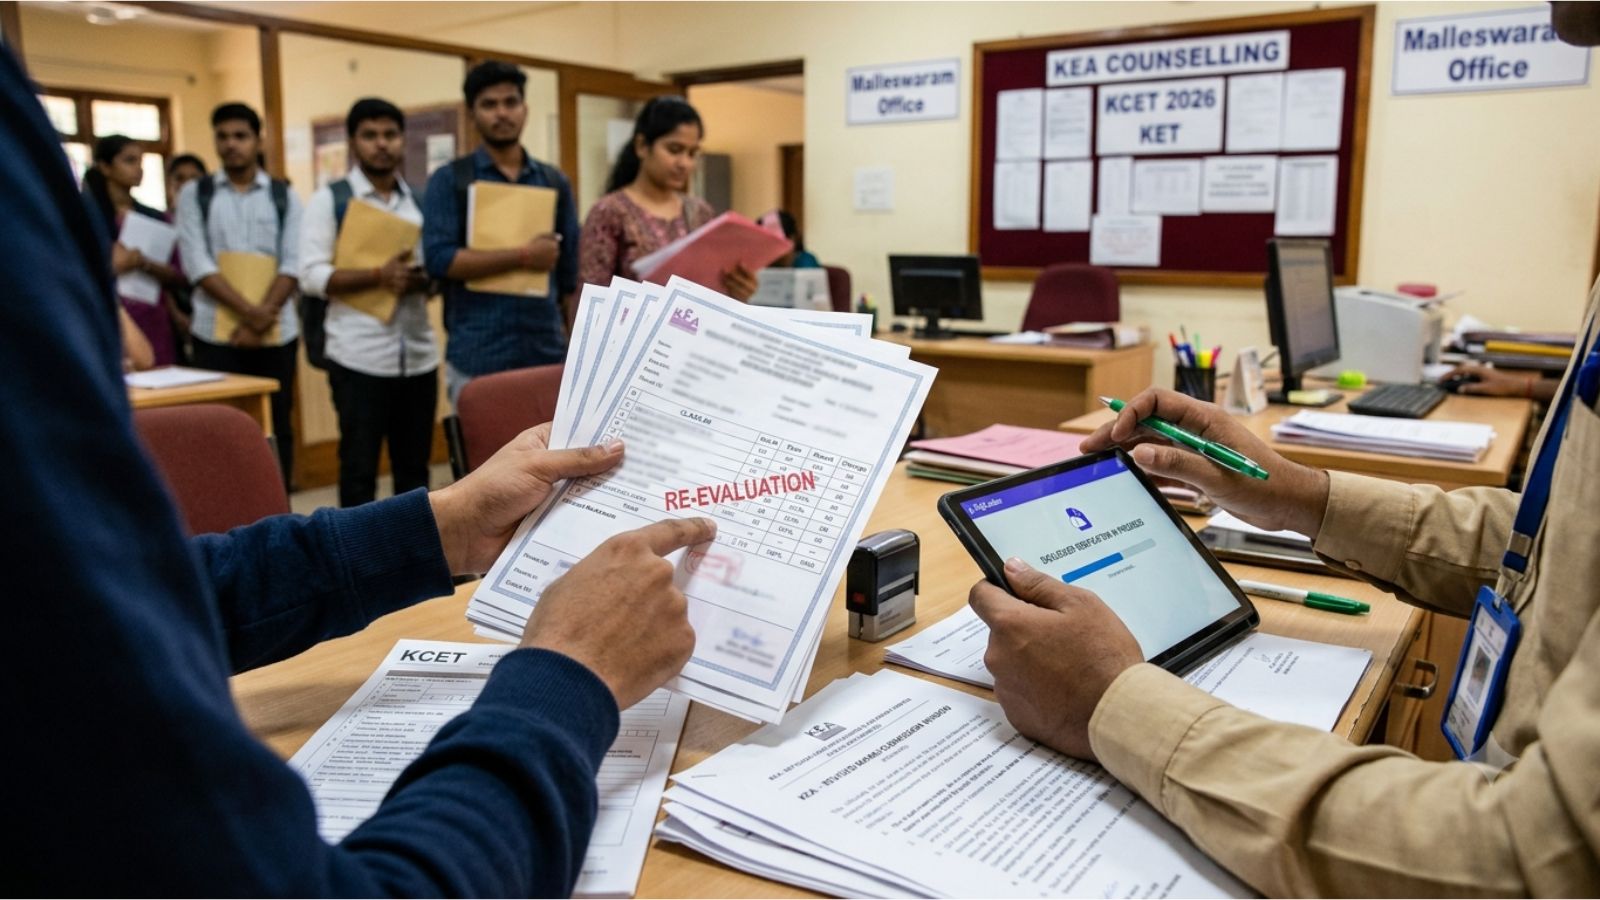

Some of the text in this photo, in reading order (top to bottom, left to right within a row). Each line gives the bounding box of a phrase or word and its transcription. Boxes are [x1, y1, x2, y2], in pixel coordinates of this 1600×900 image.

[1404, 24, 1558, 52] Malleswara
[1054, 40, 1280, 79] KEA COUNSELLING
[1449, 56, 1529, 82] Office
[851, 71, 955, 92] Malleswaram
[877, 95, 925, 116] Office
[1105, 88, 1217, 114] KCET 2026
[1140, 123, 1181, 145] KET
[672, 306, 700, 329] KEA
[664, 470, 817, 512] RE-EVALUATION
[400, 649, 468, 664] KCET
[803, 720, 837, 738] KEA
